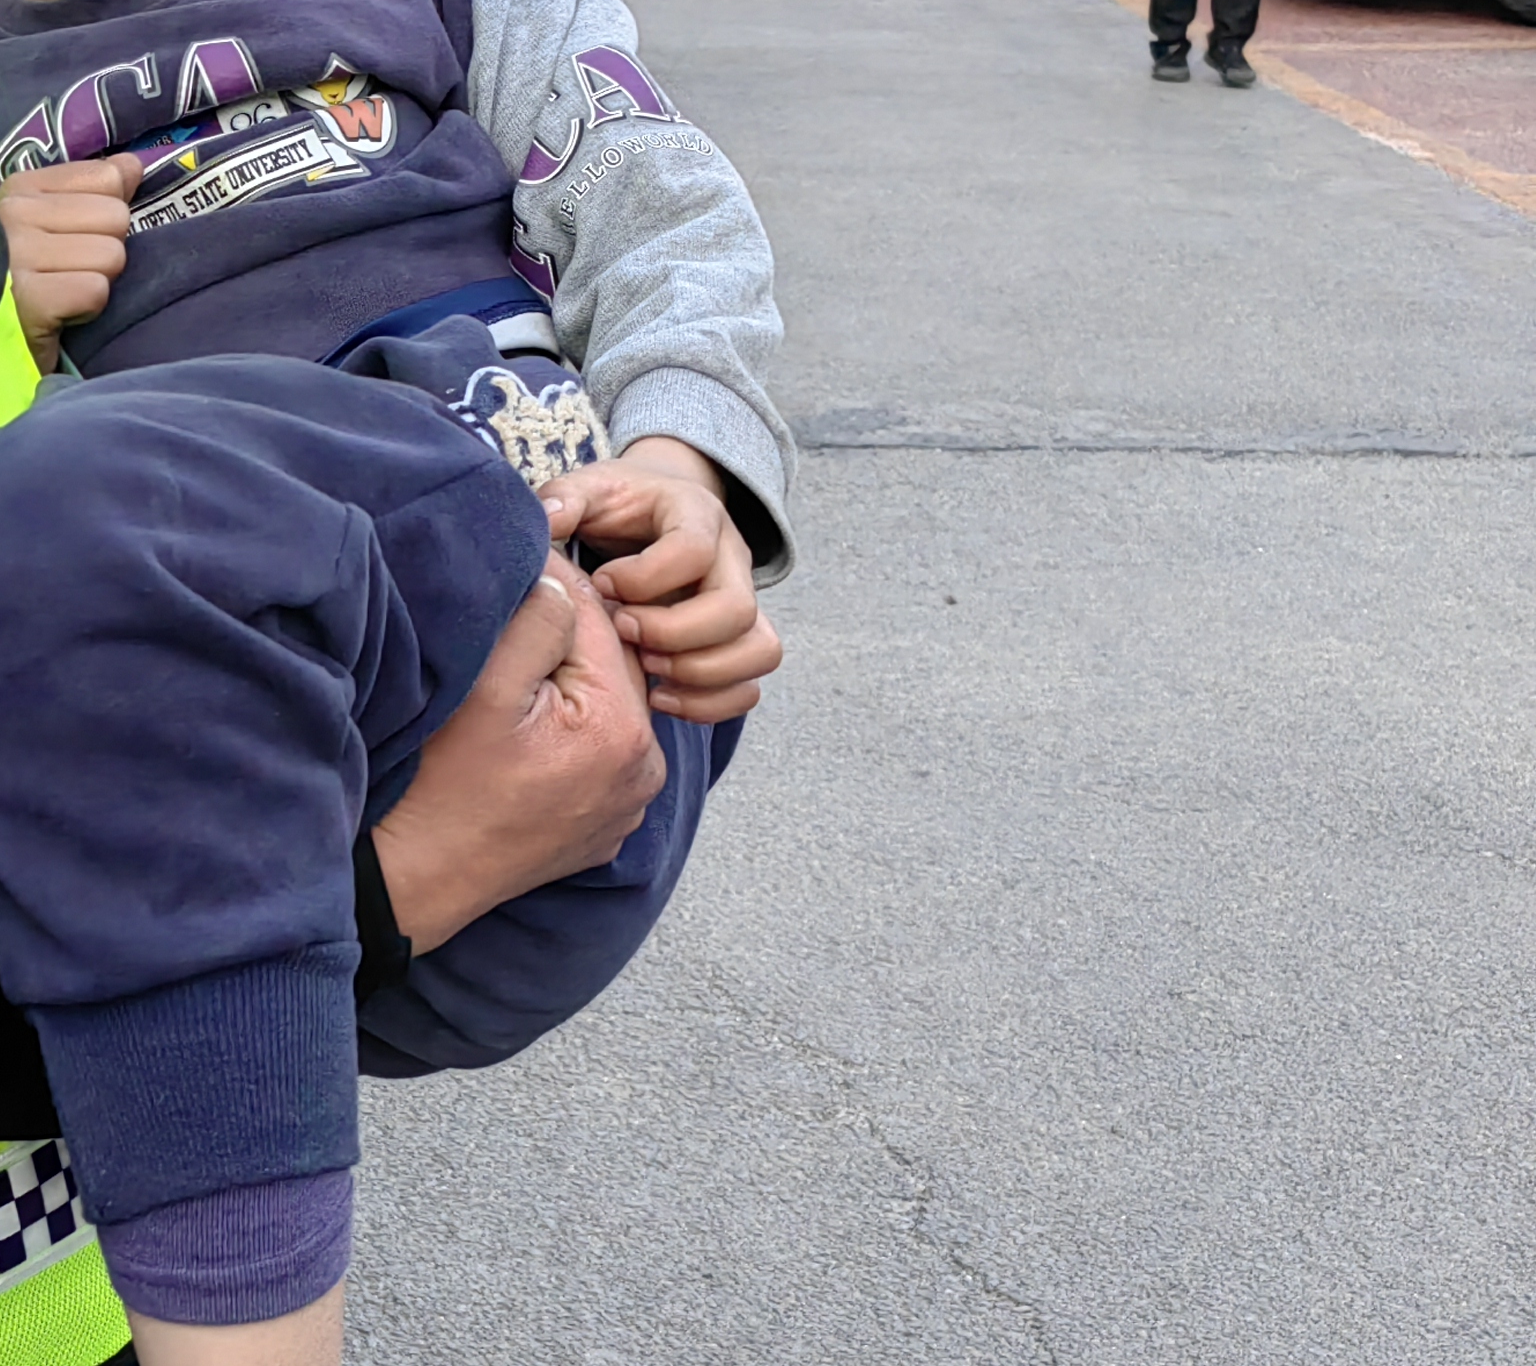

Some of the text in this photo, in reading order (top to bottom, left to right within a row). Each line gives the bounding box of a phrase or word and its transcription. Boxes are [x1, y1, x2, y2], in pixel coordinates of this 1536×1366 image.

[182, 176, 228, 214] STATE
[225, 137, 313, 189] UNIVERSITY
[558, 131, 714, 237] ELLO WORLD
